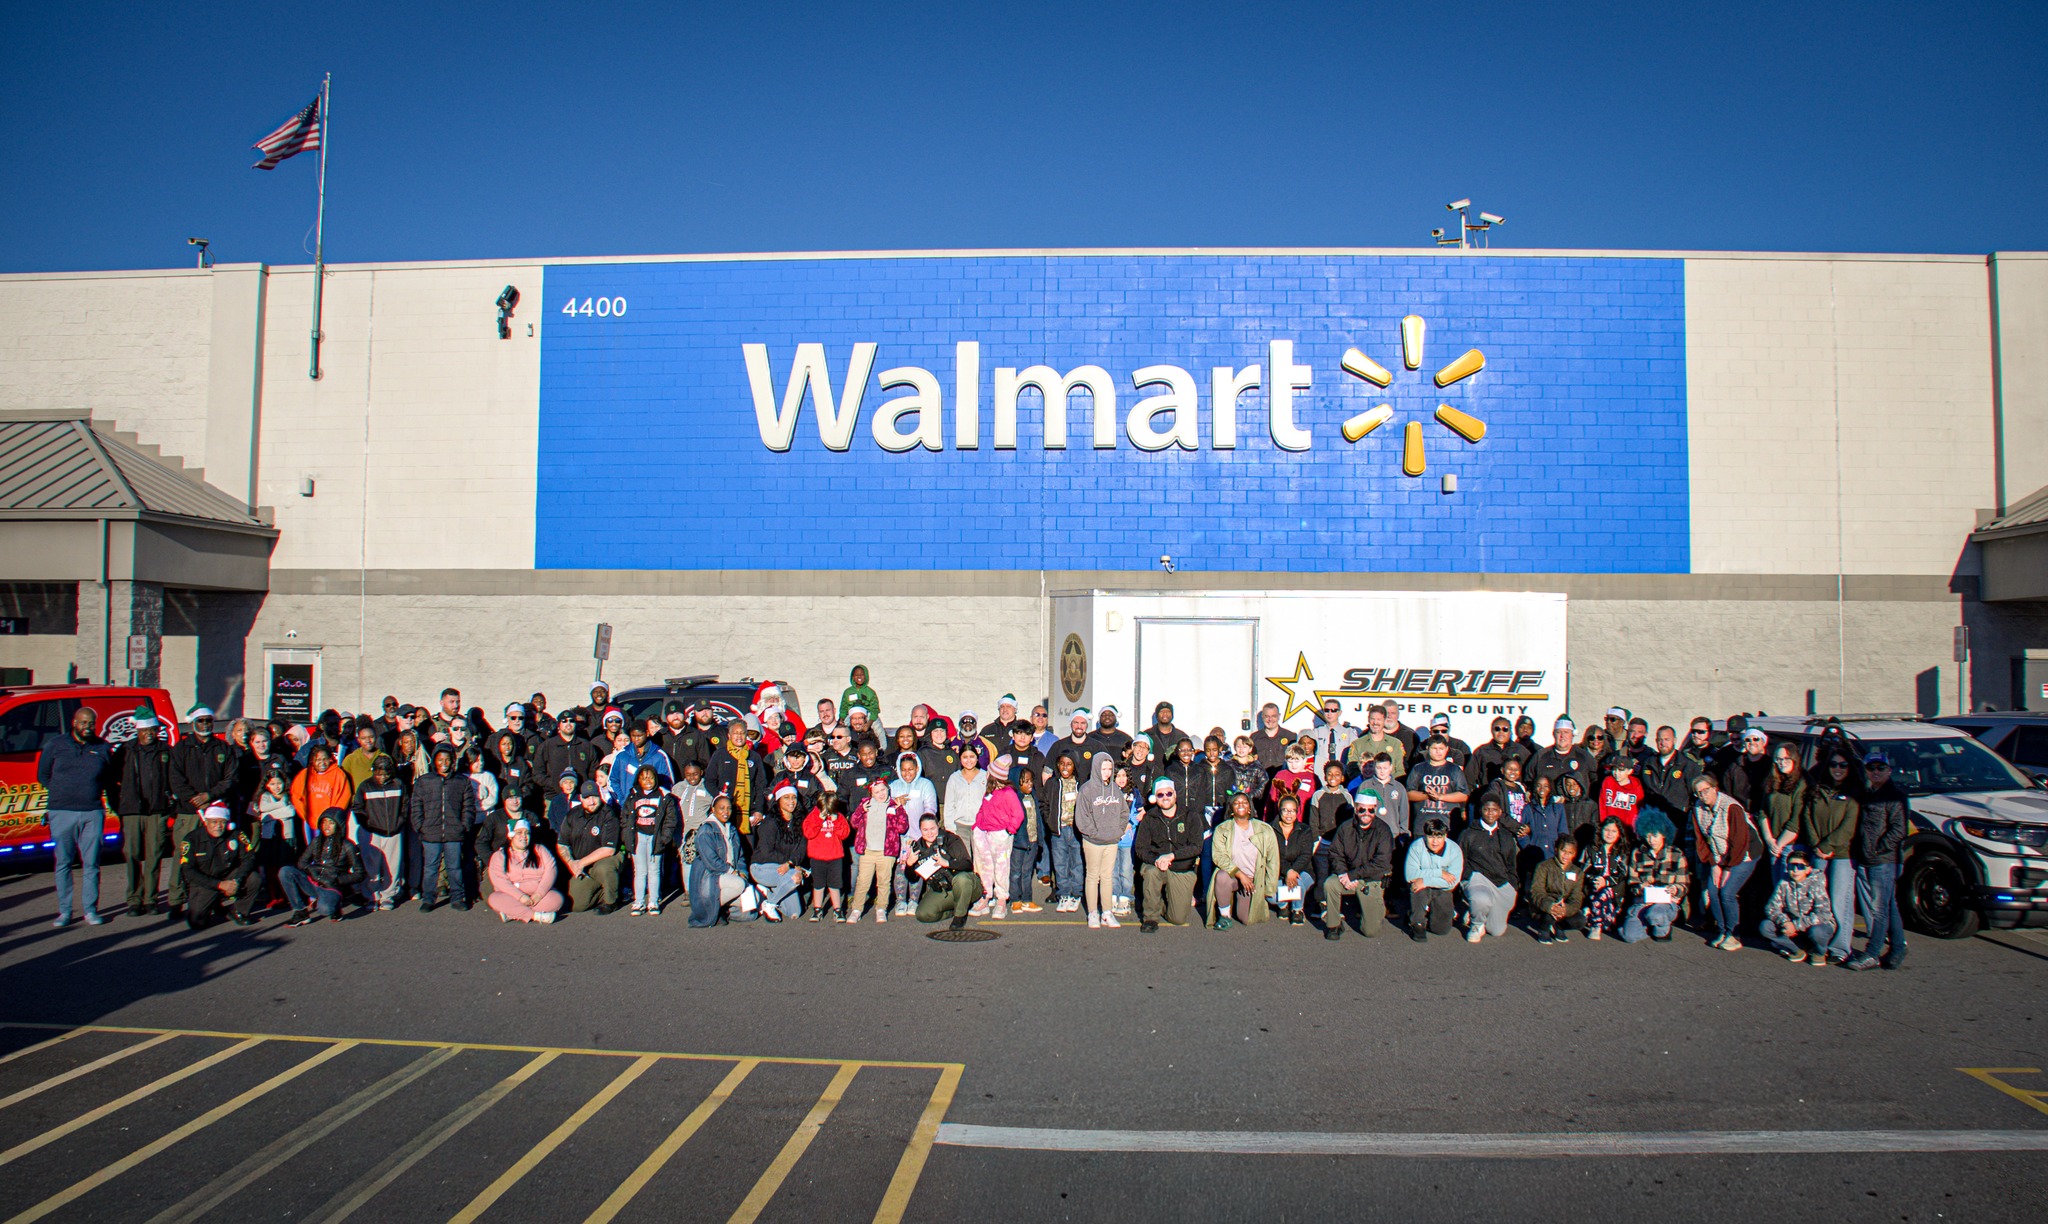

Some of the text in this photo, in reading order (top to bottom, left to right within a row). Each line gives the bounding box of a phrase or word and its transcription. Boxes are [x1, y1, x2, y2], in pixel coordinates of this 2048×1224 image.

[562, 297, 627, 317] 4400
[742, 340, 1312, 452] Walmart
[1340, 668, 1546, 696] SHERIFF
[1354, 703, 1432, 713] JAPER
[1447, 704, 1528, 715] COUNTY
[1423, 775, 1450, 785] GOD
